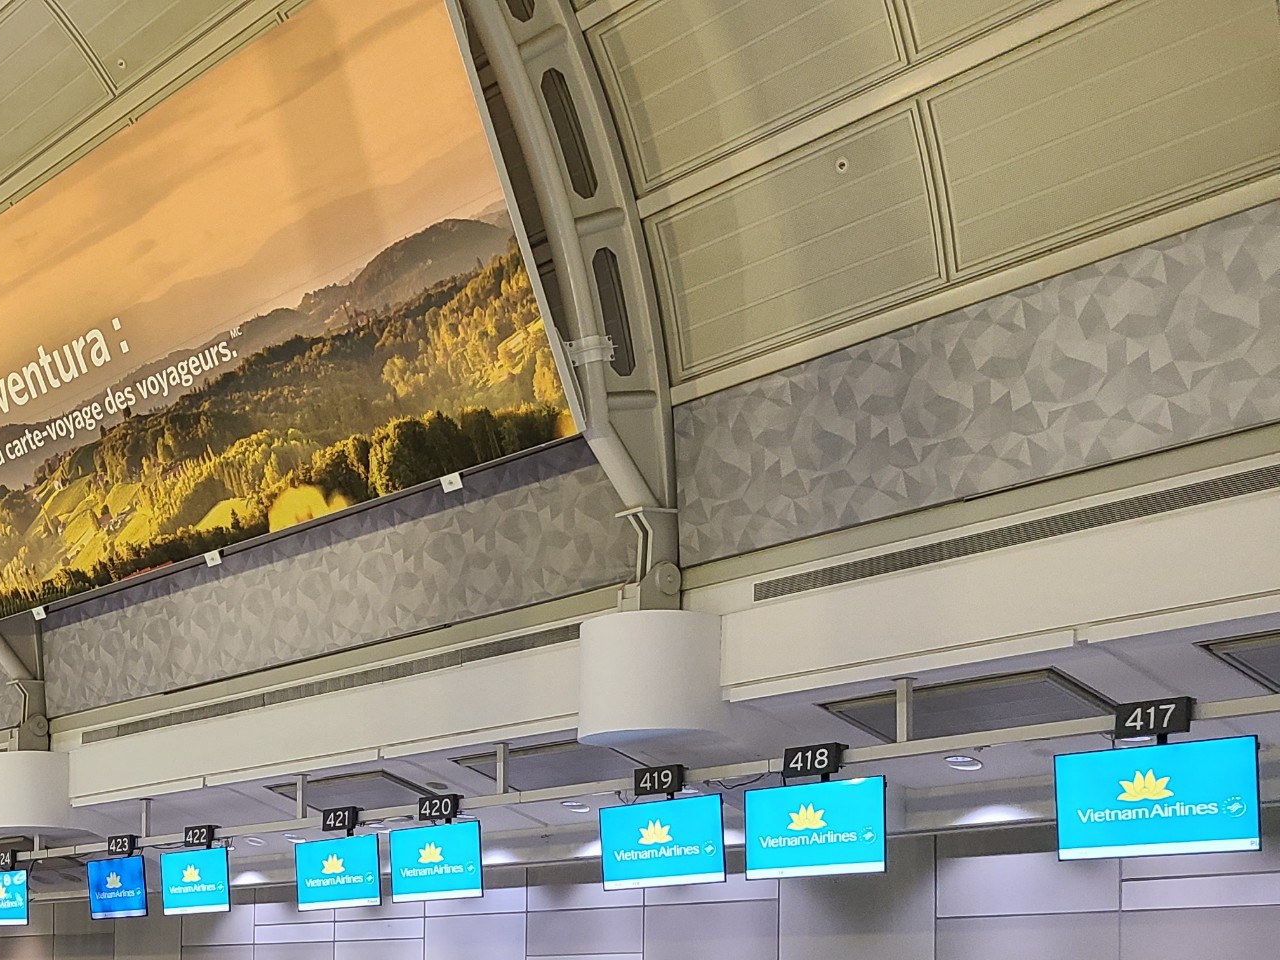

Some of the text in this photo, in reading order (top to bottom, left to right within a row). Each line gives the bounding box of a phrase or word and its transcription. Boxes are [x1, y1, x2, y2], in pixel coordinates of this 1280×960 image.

[5, 402, 104, 459] carte-voyage
[104, 386, 136, 414] des
[135, 340, 239, 400] voyageurs.
[1124, 703, 1176, 731] 417
[788, 748, 829, 771] 418
[639, 769, 672, 791] 419
[420, 798, 451, 817] 420
[1077, 801, 1219, 824] Vietnam Airlines
[325, 810, 349, 828] 421
[109, 837, 129, 852] 423
[185, 828, 207, 844] 422
[758, 830, 858, 849] Vietnam Airlines
[613, 844, 700, 863] Vietnam Airlines
[399, 863, 464, 878] Vietnam Airlines
[305, 874, 364, 888] Vietnam Airlines
